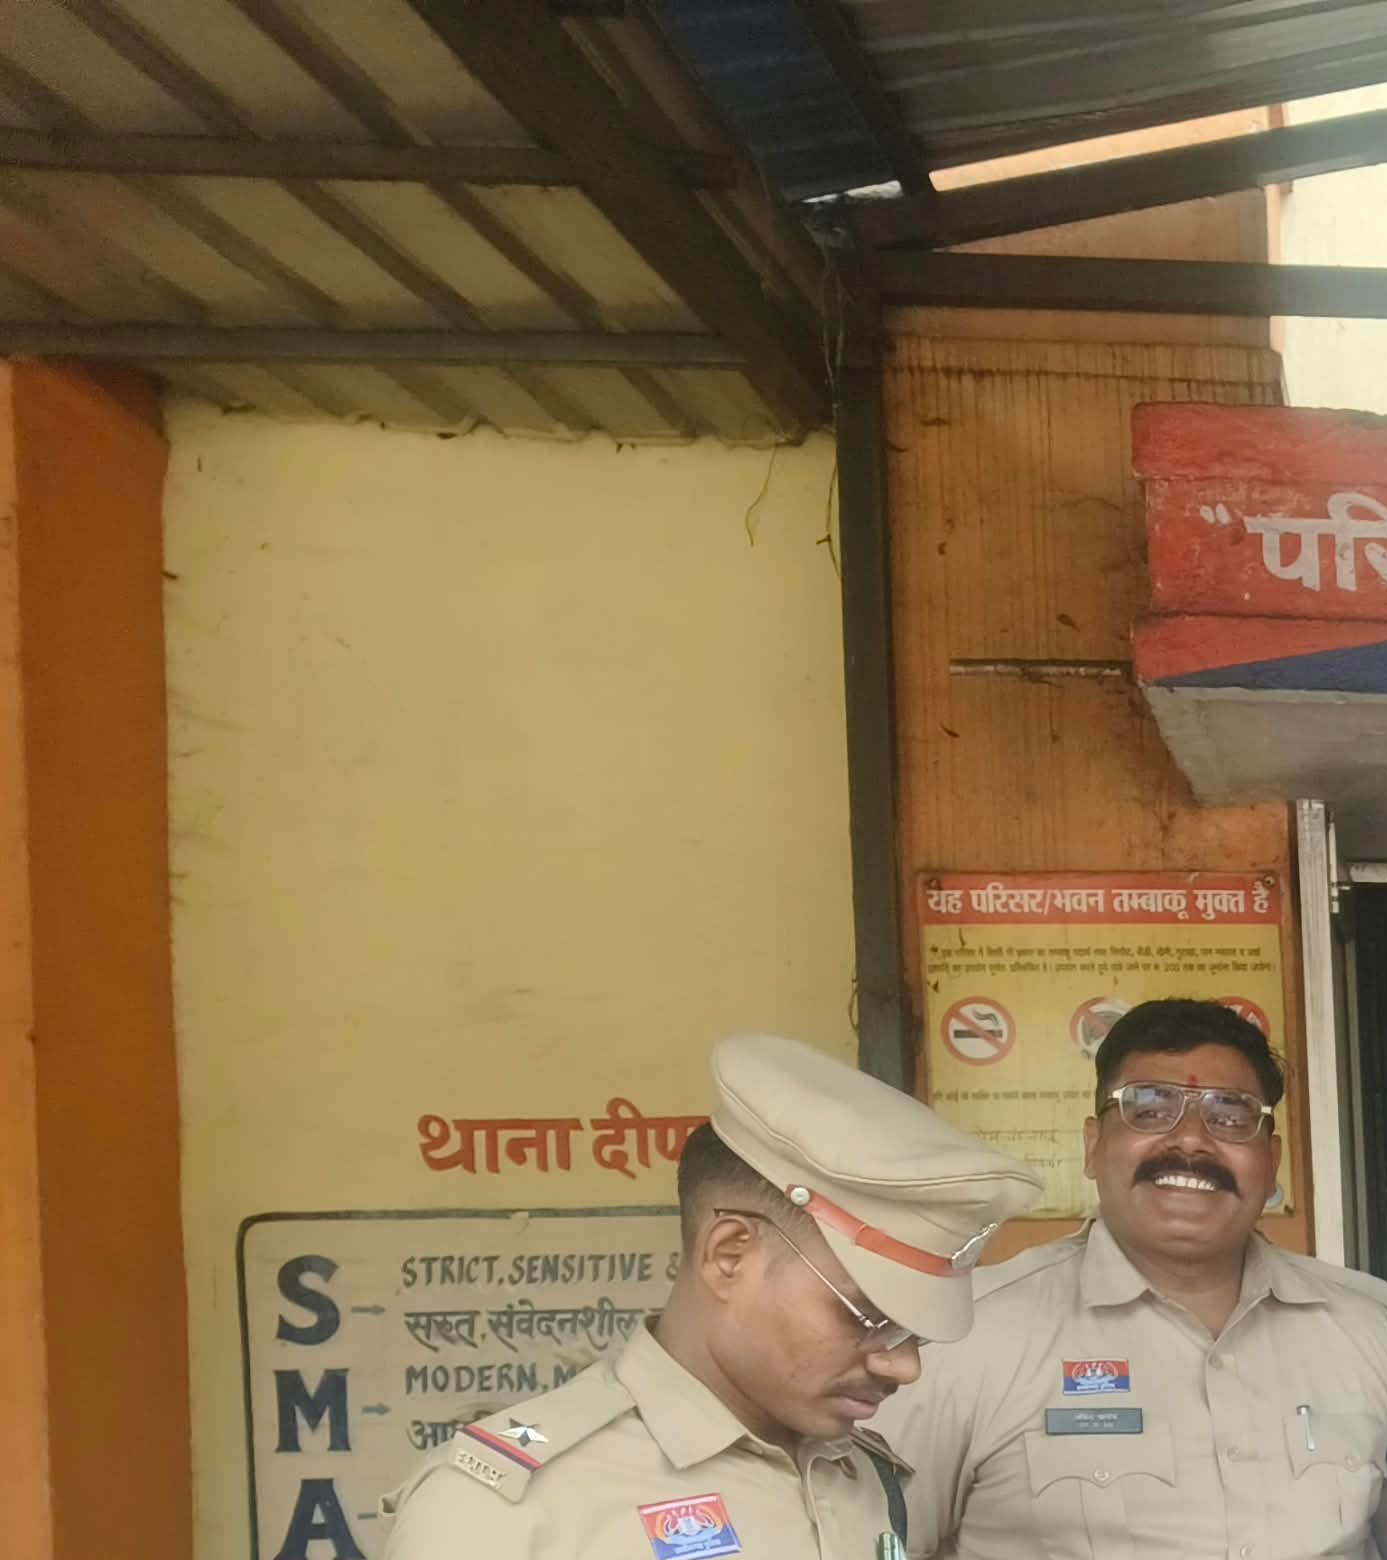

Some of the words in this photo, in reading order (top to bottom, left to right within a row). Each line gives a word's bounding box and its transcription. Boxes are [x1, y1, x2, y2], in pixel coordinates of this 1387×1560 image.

[927, 888, 962, 914] यह
[969, 883, 1105, 916] परिसर/भवन
[1112, 888, 1190, 921] तम्बाकू
[1193, 888, 1246, 921] मुक्त
[1253, 881, 1271, 914] है
[416, 1114, 585, 1175] थाना
[507, 1252, 653, 1287] SENSITIVE
[486, 1296, 646, 1352] संवेदनशील
